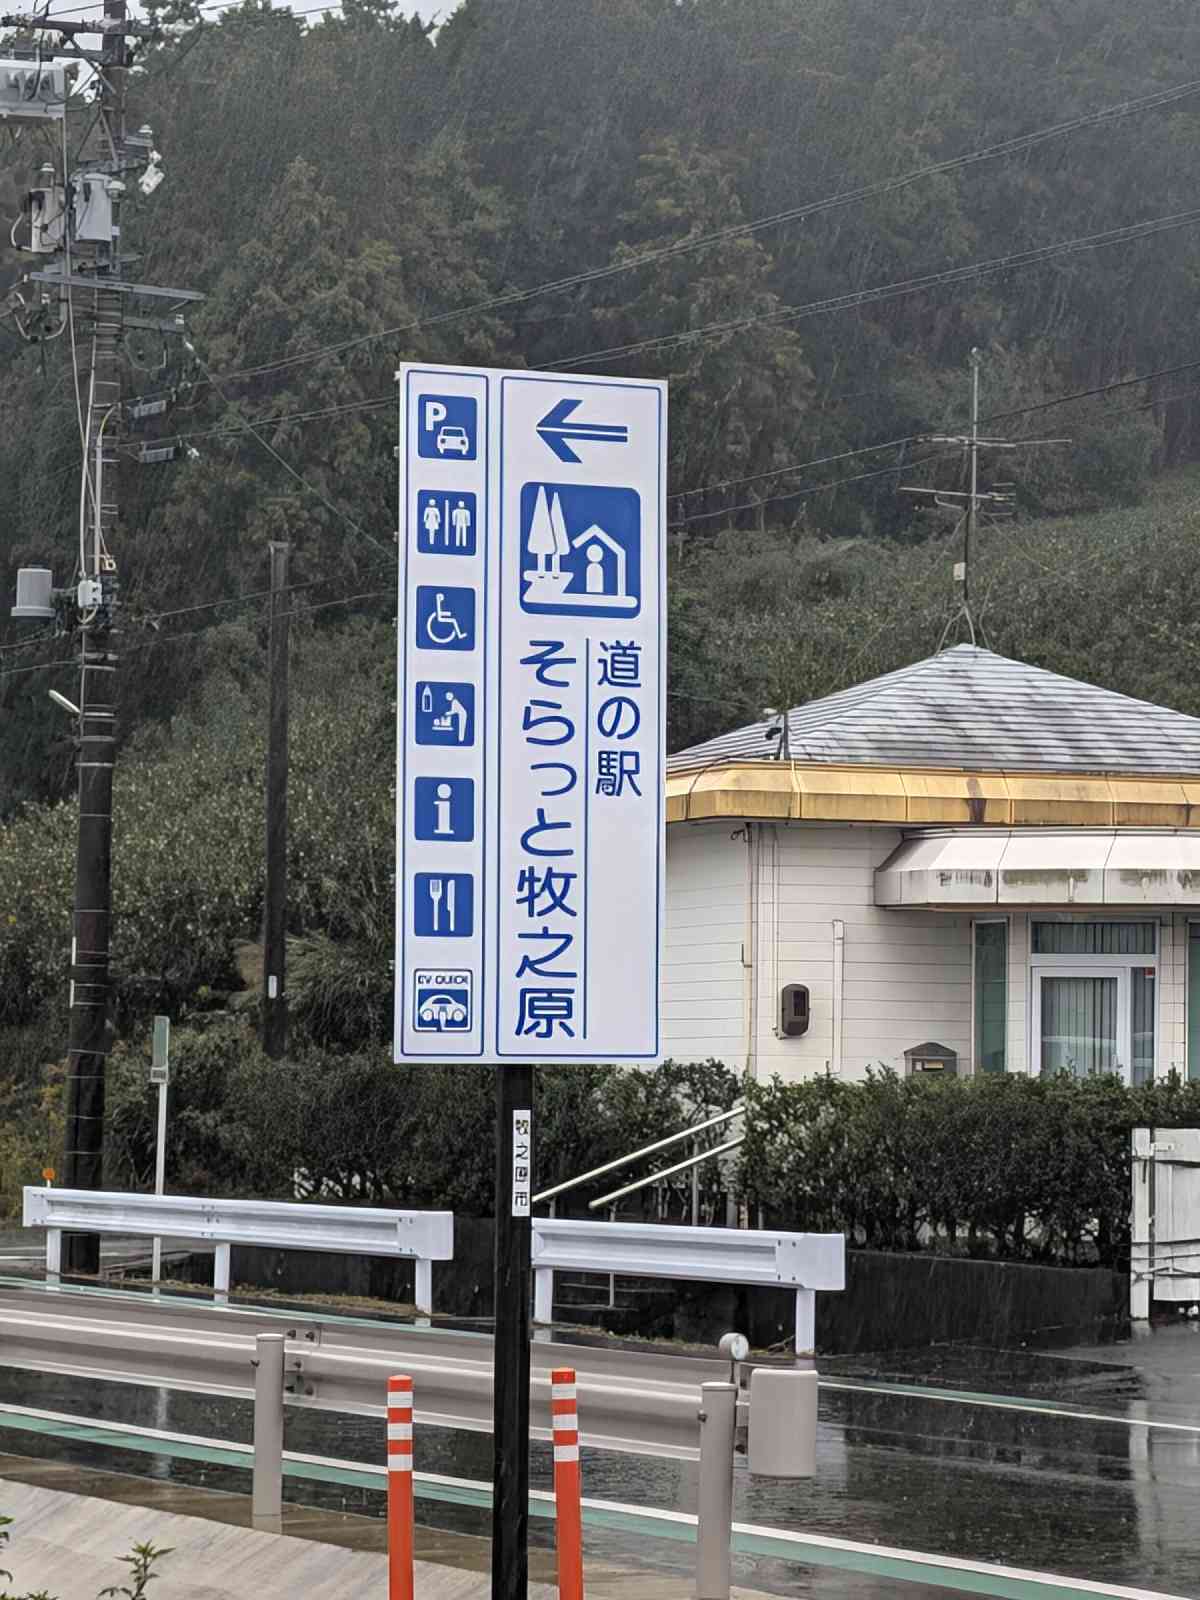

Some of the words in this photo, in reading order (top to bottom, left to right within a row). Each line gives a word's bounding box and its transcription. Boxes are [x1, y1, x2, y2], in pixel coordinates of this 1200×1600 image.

[424, 401, 447, 431] P
[595, 640, 643, 797] 道の駅
[514, 640, 578, 1039] そらっと牧之原
[417, 975, 432, 985] EV
